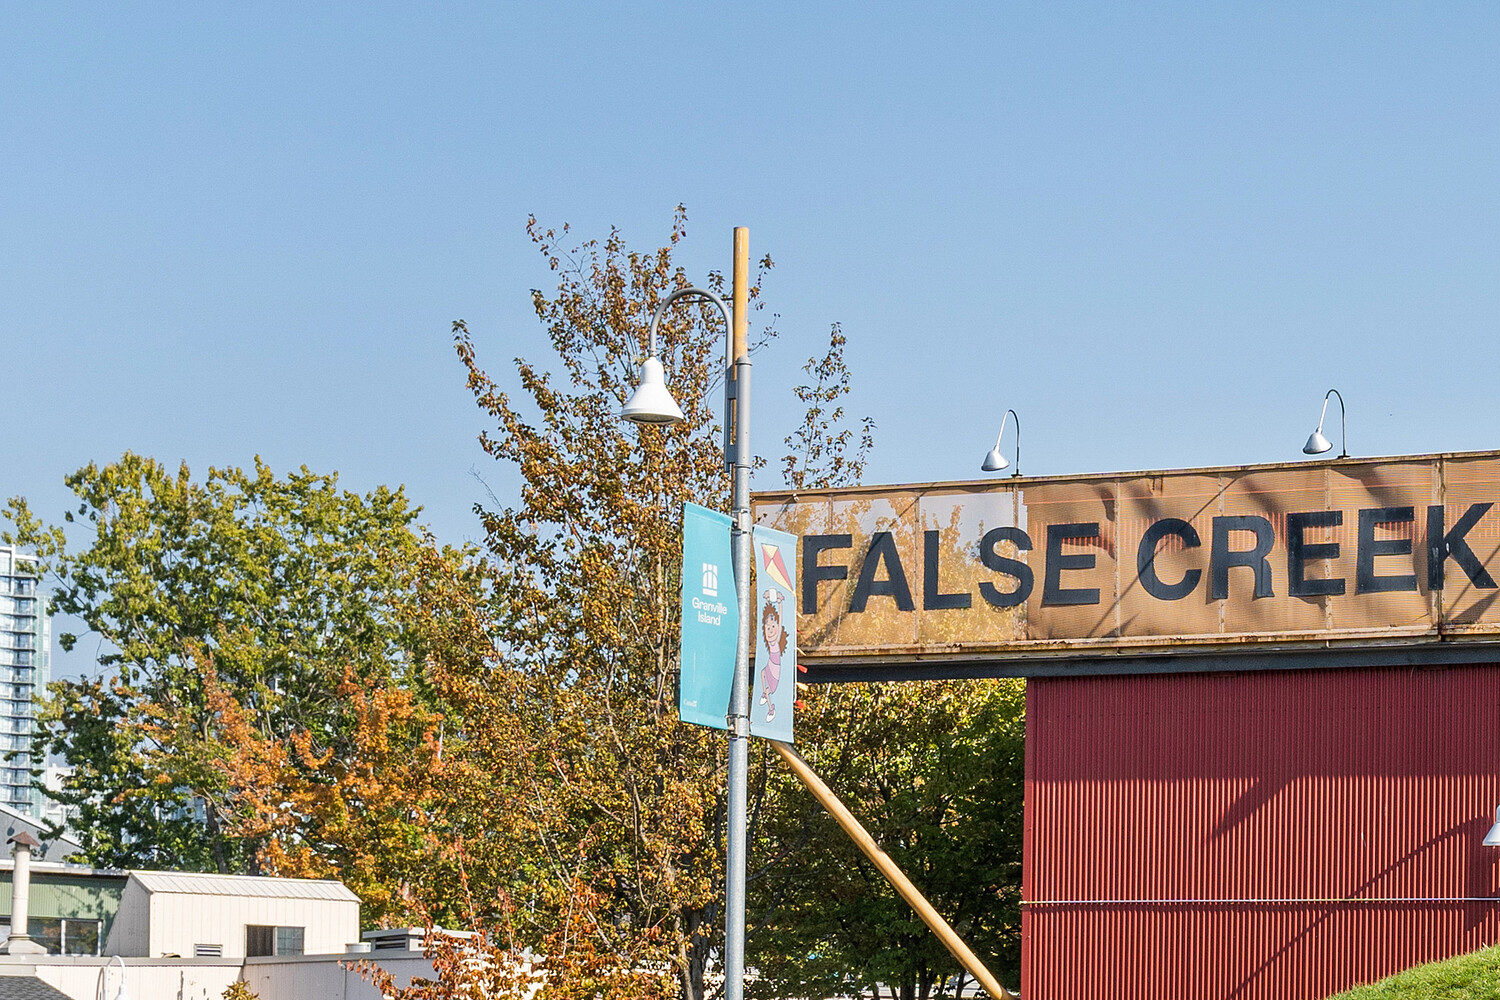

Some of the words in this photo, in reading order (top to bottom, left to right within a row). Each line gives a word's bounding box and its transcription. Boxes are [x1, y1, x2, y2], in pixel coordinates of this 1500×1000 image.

[803, 523, 1100, 614] FALSE
[1137, 502, 1498, 601] CREEK
[691, 596, 728, 615] Granville
[697, 610, 721, 626] Island
